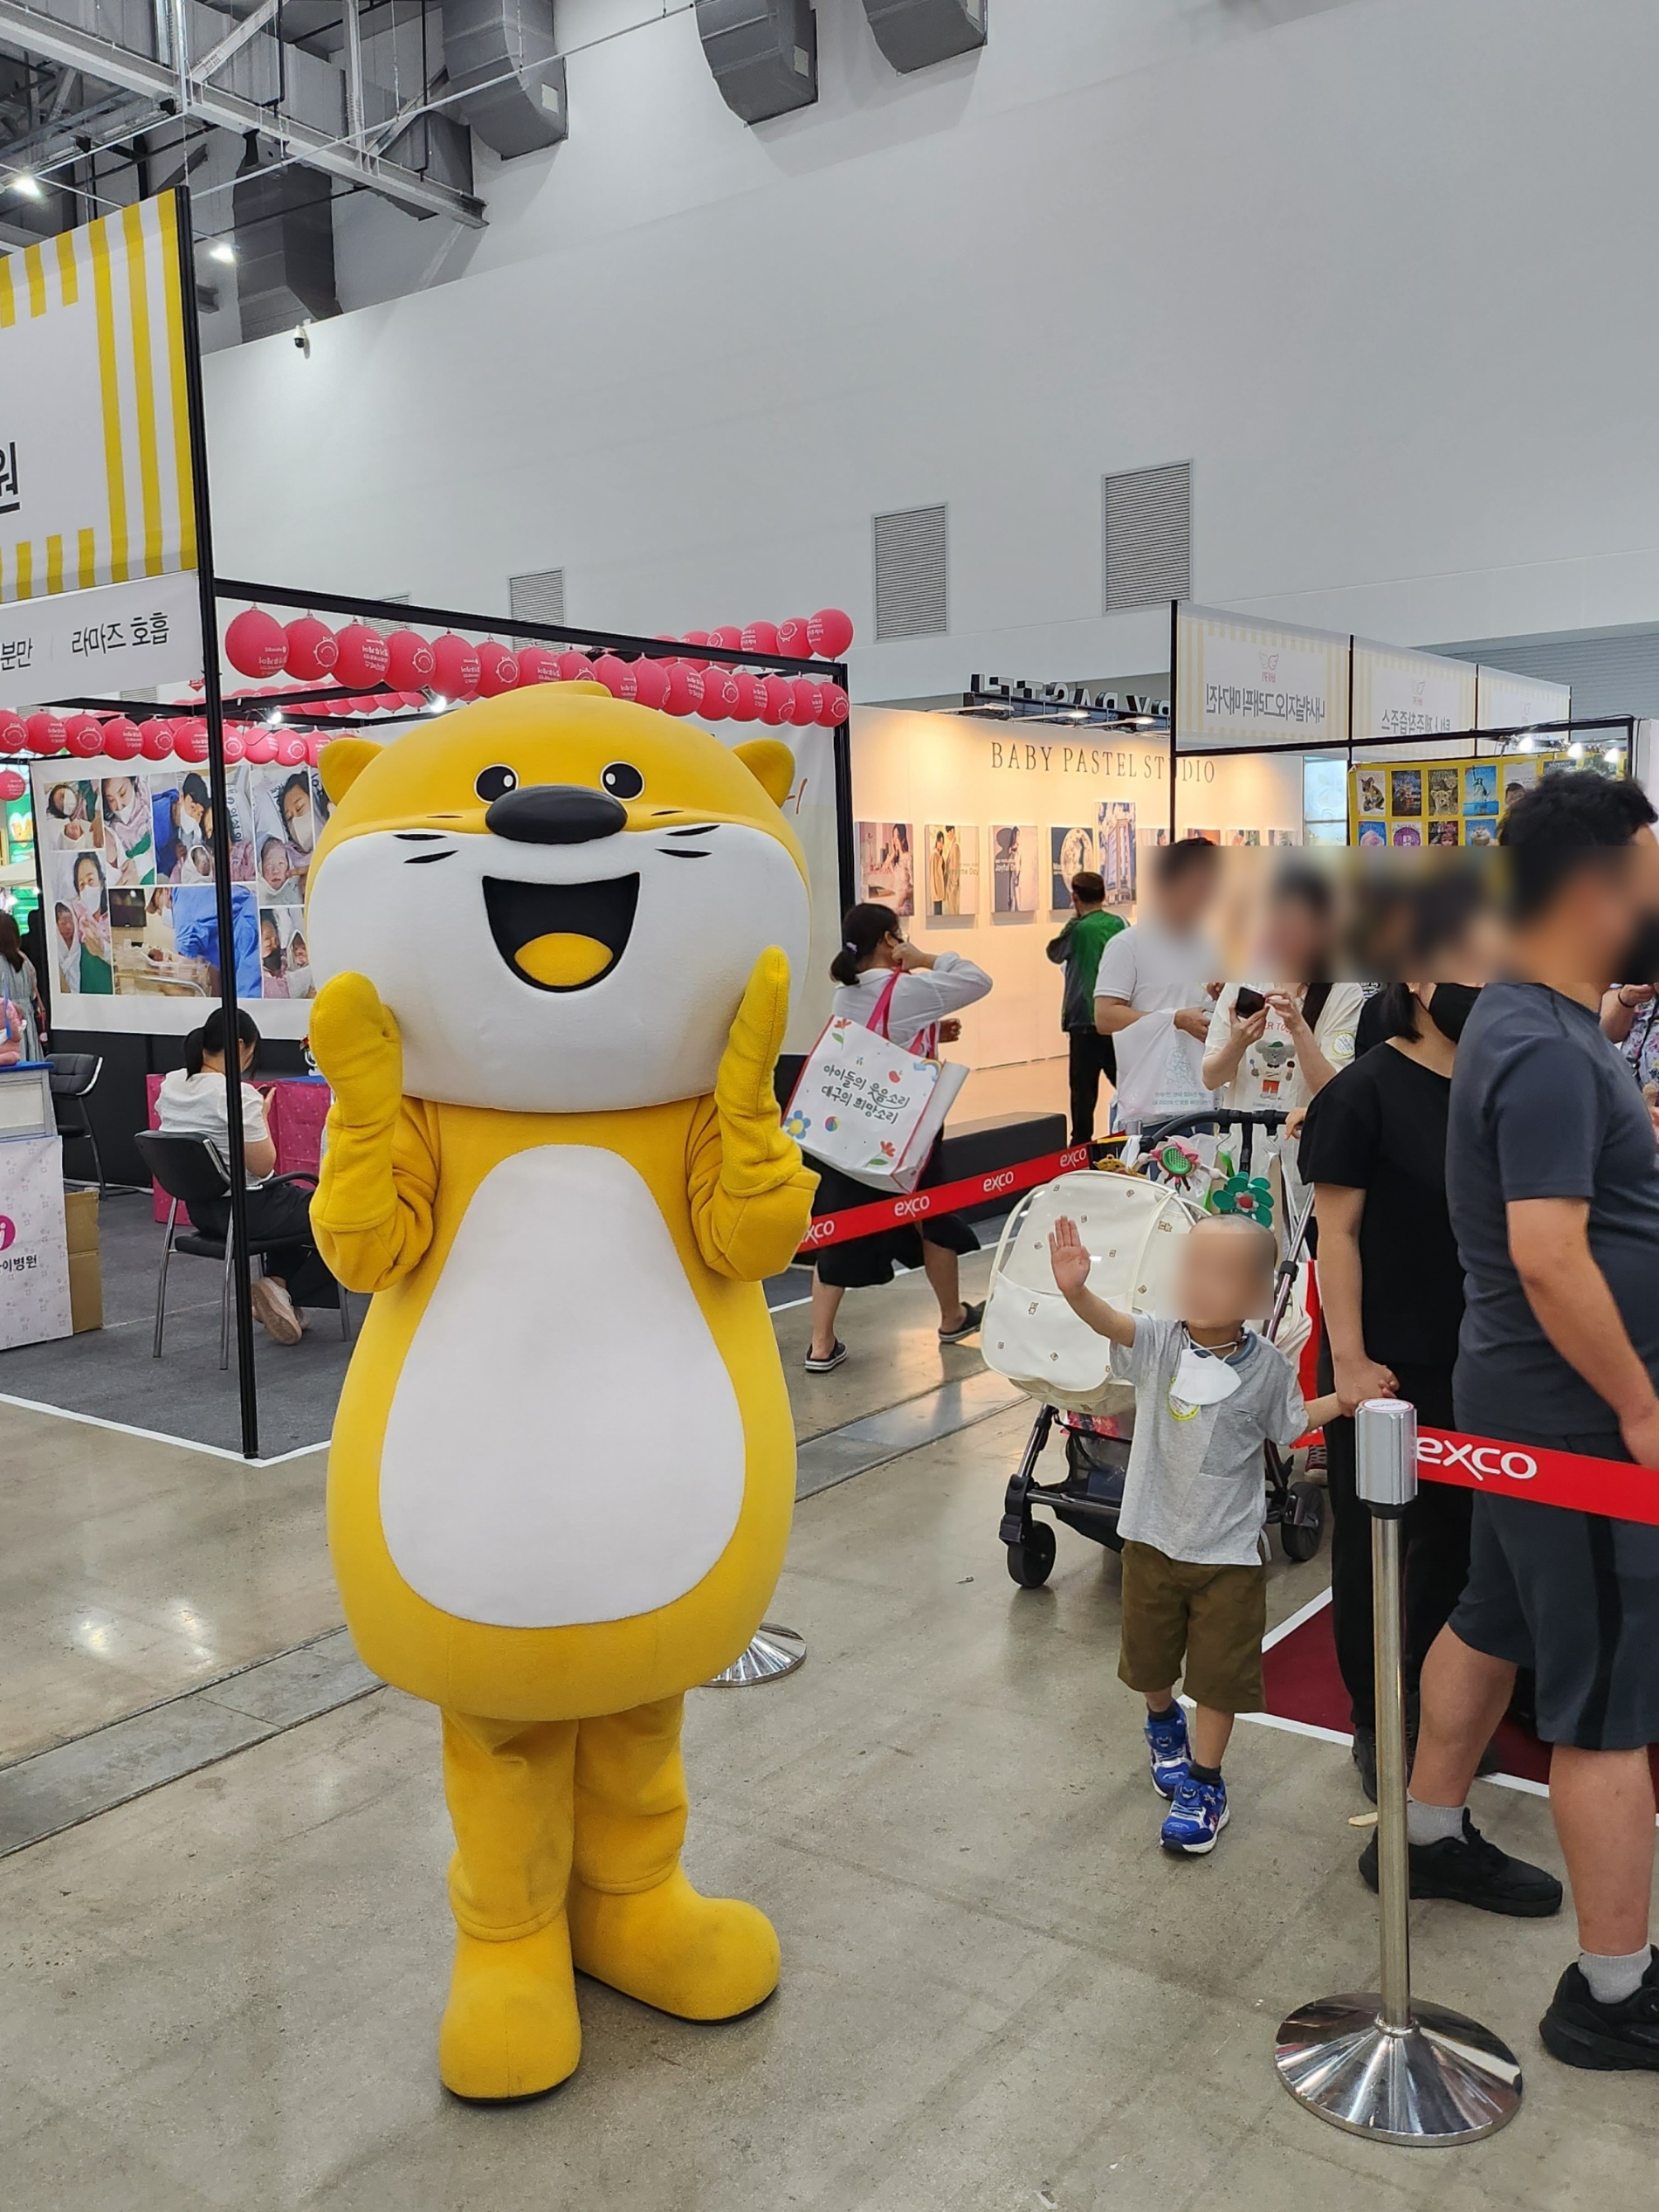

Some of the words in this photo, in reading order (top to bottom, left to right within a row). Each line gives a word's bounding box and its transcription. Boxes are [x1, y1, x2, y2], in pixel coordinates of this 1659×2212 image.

[72, 623, 127, 658] 라마즈
[130, 612, 170, 647] 호흡
[991, 741, 1052, 772] BABY
[1063, 748, 1138, 778] PASTEL
[1144, 755, 1215, 783] STDIO
[821, 1085, 852, 1106] 대구의
[853, 1098, 898, 1124] 희망소리
[823, 1065, 866, 1090] 아이들의
[867, 1083, 910, 1109] 웃음소리
[802, 1220, 835, 1245] xco
[894, 1196, 930, 1217] exco
[983, 1171, 1014, 1192] exco
[1059, 1147, 1086, 1168] exco
[0, 1254, 38, 1272] 이병원
[1416, 1437, 1538, 1482] exco
